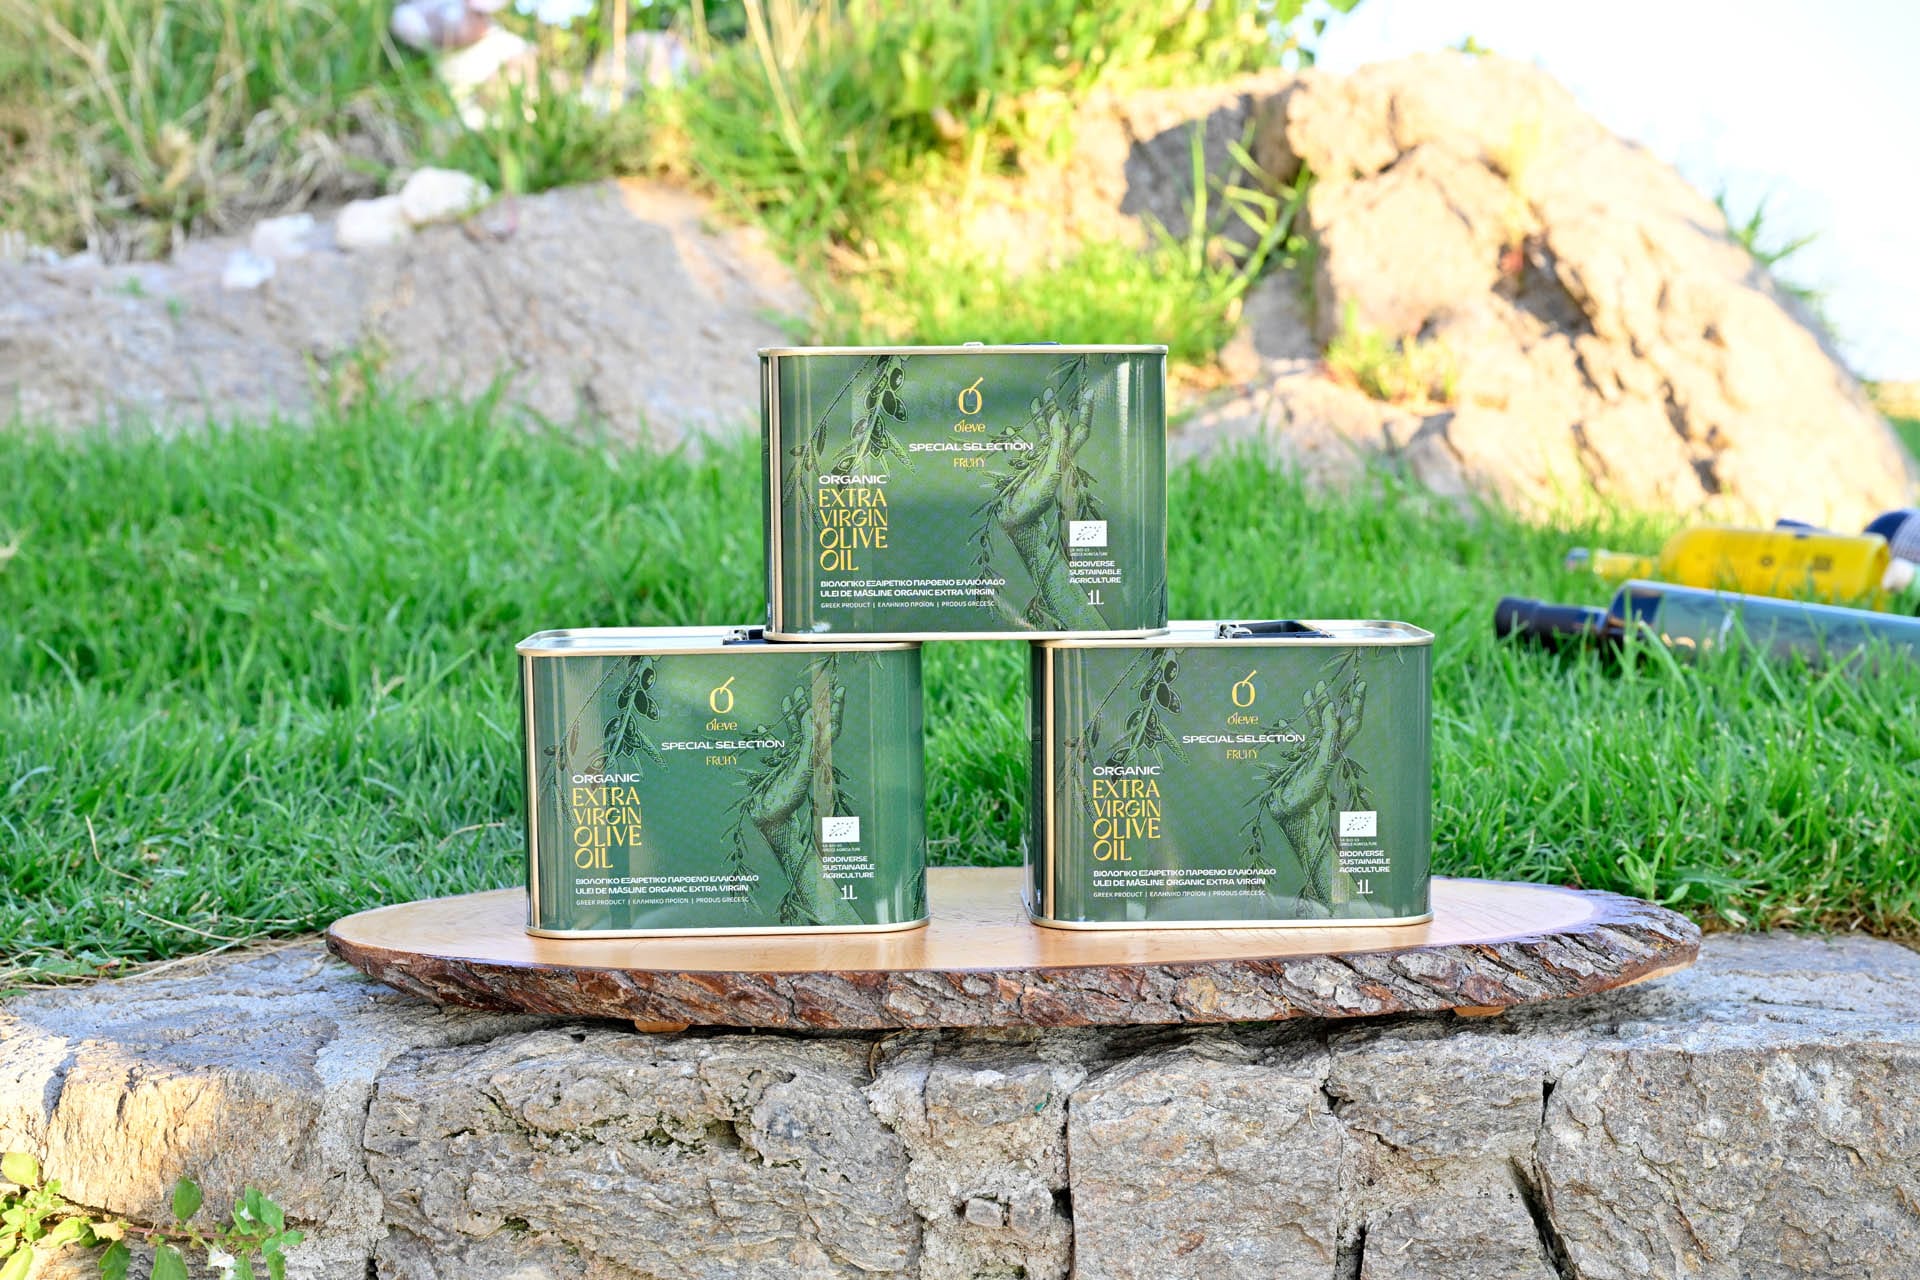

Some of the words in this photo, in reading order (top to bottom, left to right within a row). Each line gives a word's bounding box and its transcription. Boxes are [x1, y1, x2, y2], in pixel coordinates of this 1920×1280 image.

[909, 443, 961, 452] SPECIAL
[963, 442, 1034, 451] SELECTION
[819, 474, 888, 484] ORGANIC
[818, 488, 887, 507] EXTRA
[819, 508, 888, 527] VIRGIN
[820, 527, 888, 549] OLIVE
[820, 549, 859, 571] OIL
[820, 590, 839, 598] ULEI
[841, 590, 853, 598] DE
[894, 589, 934, 597] ORGANIC
[935, 588, 964, 596] EXTRA
[966, 588, 995, 596] VIRGIN
[1088, 589, 1104, 605] 1L
[661, 741, 713, 750] SPECIAL
[716, 740, 785, 749] SELECTION
[1182, 735, 1235, 744] SPECIAL
[1236, 734, 1306, 743] SELECTION
[572, 774, 640, 784] ORGANIC
[1093, 766, 1161, 776] ORGANIC
[572, 786, 640, 806] EXTRA
[1092, 779, 1161, 799] EXTRA
[573, 807, 642, 826] VIRGIN
[1093, 800, 1161, 818] VIRGIN
[574, 825, 642, 847] OLIVE
[1093, 818, 1161, 840] OLIVE
[574, 848, 614, 869] OIL
[1093, 839, 1132, 862] OIL
[595, 887, 607, 895] DE
[649, 886, 688, 894] ORGANIC
[689, 885, 717, 893] EXTRA
[719, 884, 749, 892] VIRGIN
[1113, 879, 1125, 887] DE
[1166, 878, 1206, 886] ORGANIC
[1206, 878, 1235, 886] EXTRA
[1356, 879, 1374, 894] 1L
[840, 884, 858, 900] 1L
